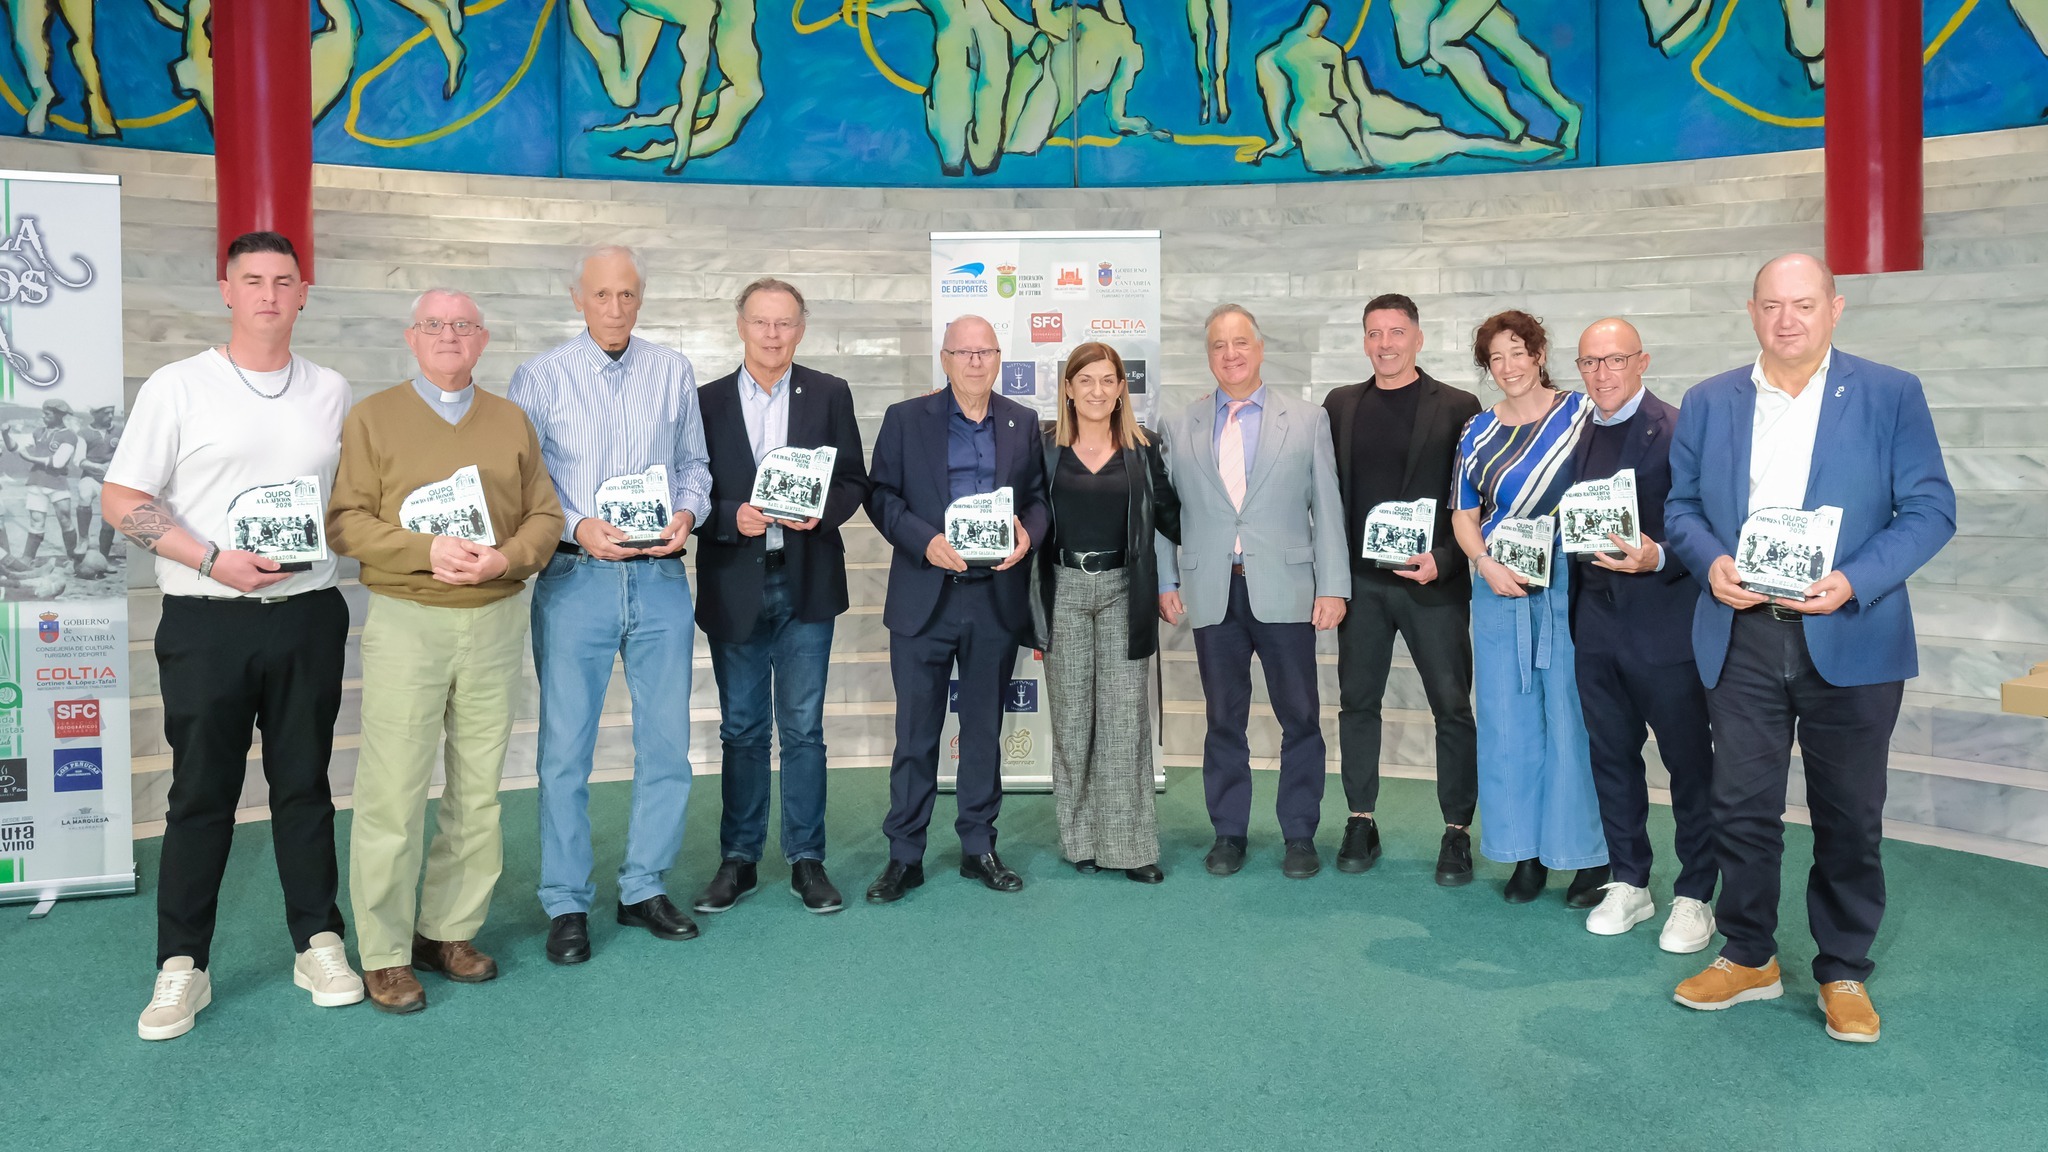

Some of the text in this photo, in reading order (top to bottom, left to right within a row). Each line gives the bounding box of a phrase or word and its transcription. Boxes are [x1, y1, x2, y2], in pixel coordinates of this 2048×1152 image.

[952, 285, 988, 293] DEPORTES
[1032, 316, 1061, 328] SFC
[1131, 371, 1145, 379] Ego
[440, 496, 456, 504] 2026
[1789, 527, 1807, 535] 2026
[63, 618, 110, 626] GOBIERNO
[63, 634, 116, 642] CANTABRIA
[56, 703, 98, 720] SFC
[56, 765, 69, 777] LOS
[72, 817, 110, 825] MARQUESA
